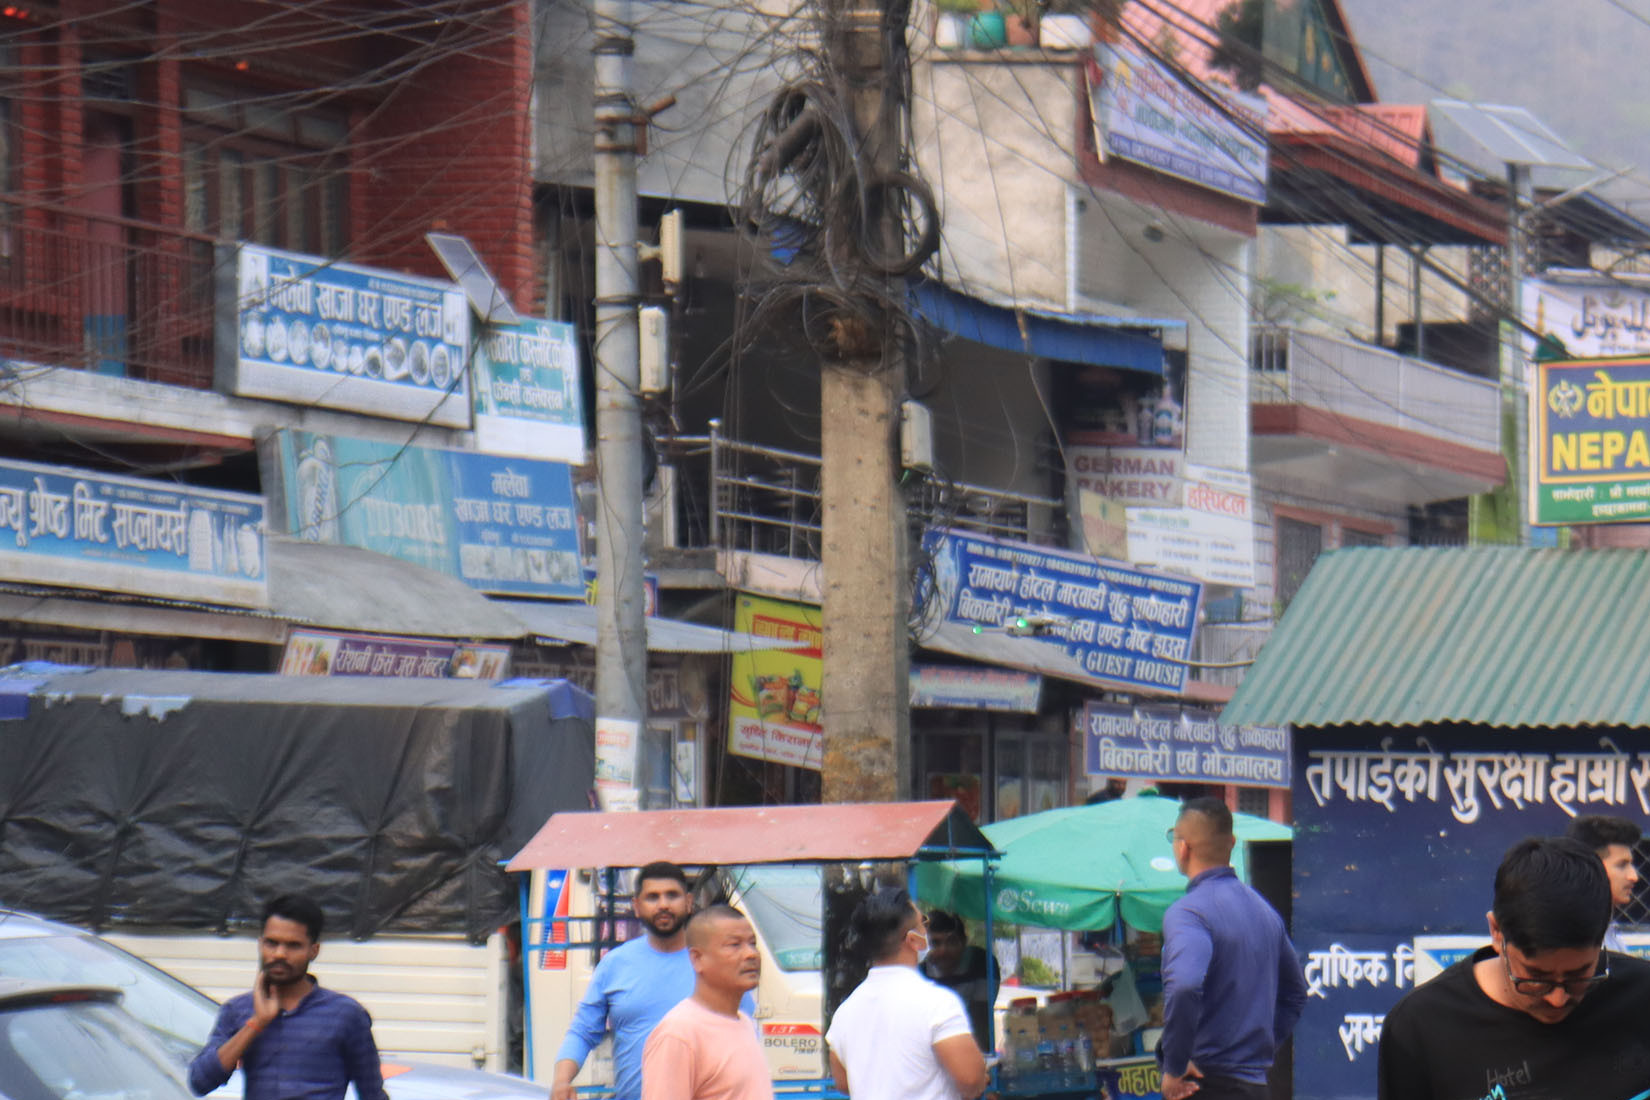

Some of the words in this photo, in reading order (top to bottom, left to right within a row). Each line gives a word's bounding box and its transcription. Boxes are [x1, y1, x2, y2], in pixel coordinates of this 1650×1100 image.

[1074, 455, 1175, 476] GERMAN
[1085, 650, 1133, 678] GUEST
[1132, 659, 1183, 687] HOUSE
[1443, 752, 1550, 824] सुरक्षा
[1549, 738, 1630, 818] हाम्रो
[1304, 942, 1390, 1000] ट्राफिक
[763, 1038, 818, 1049] BOLERO
